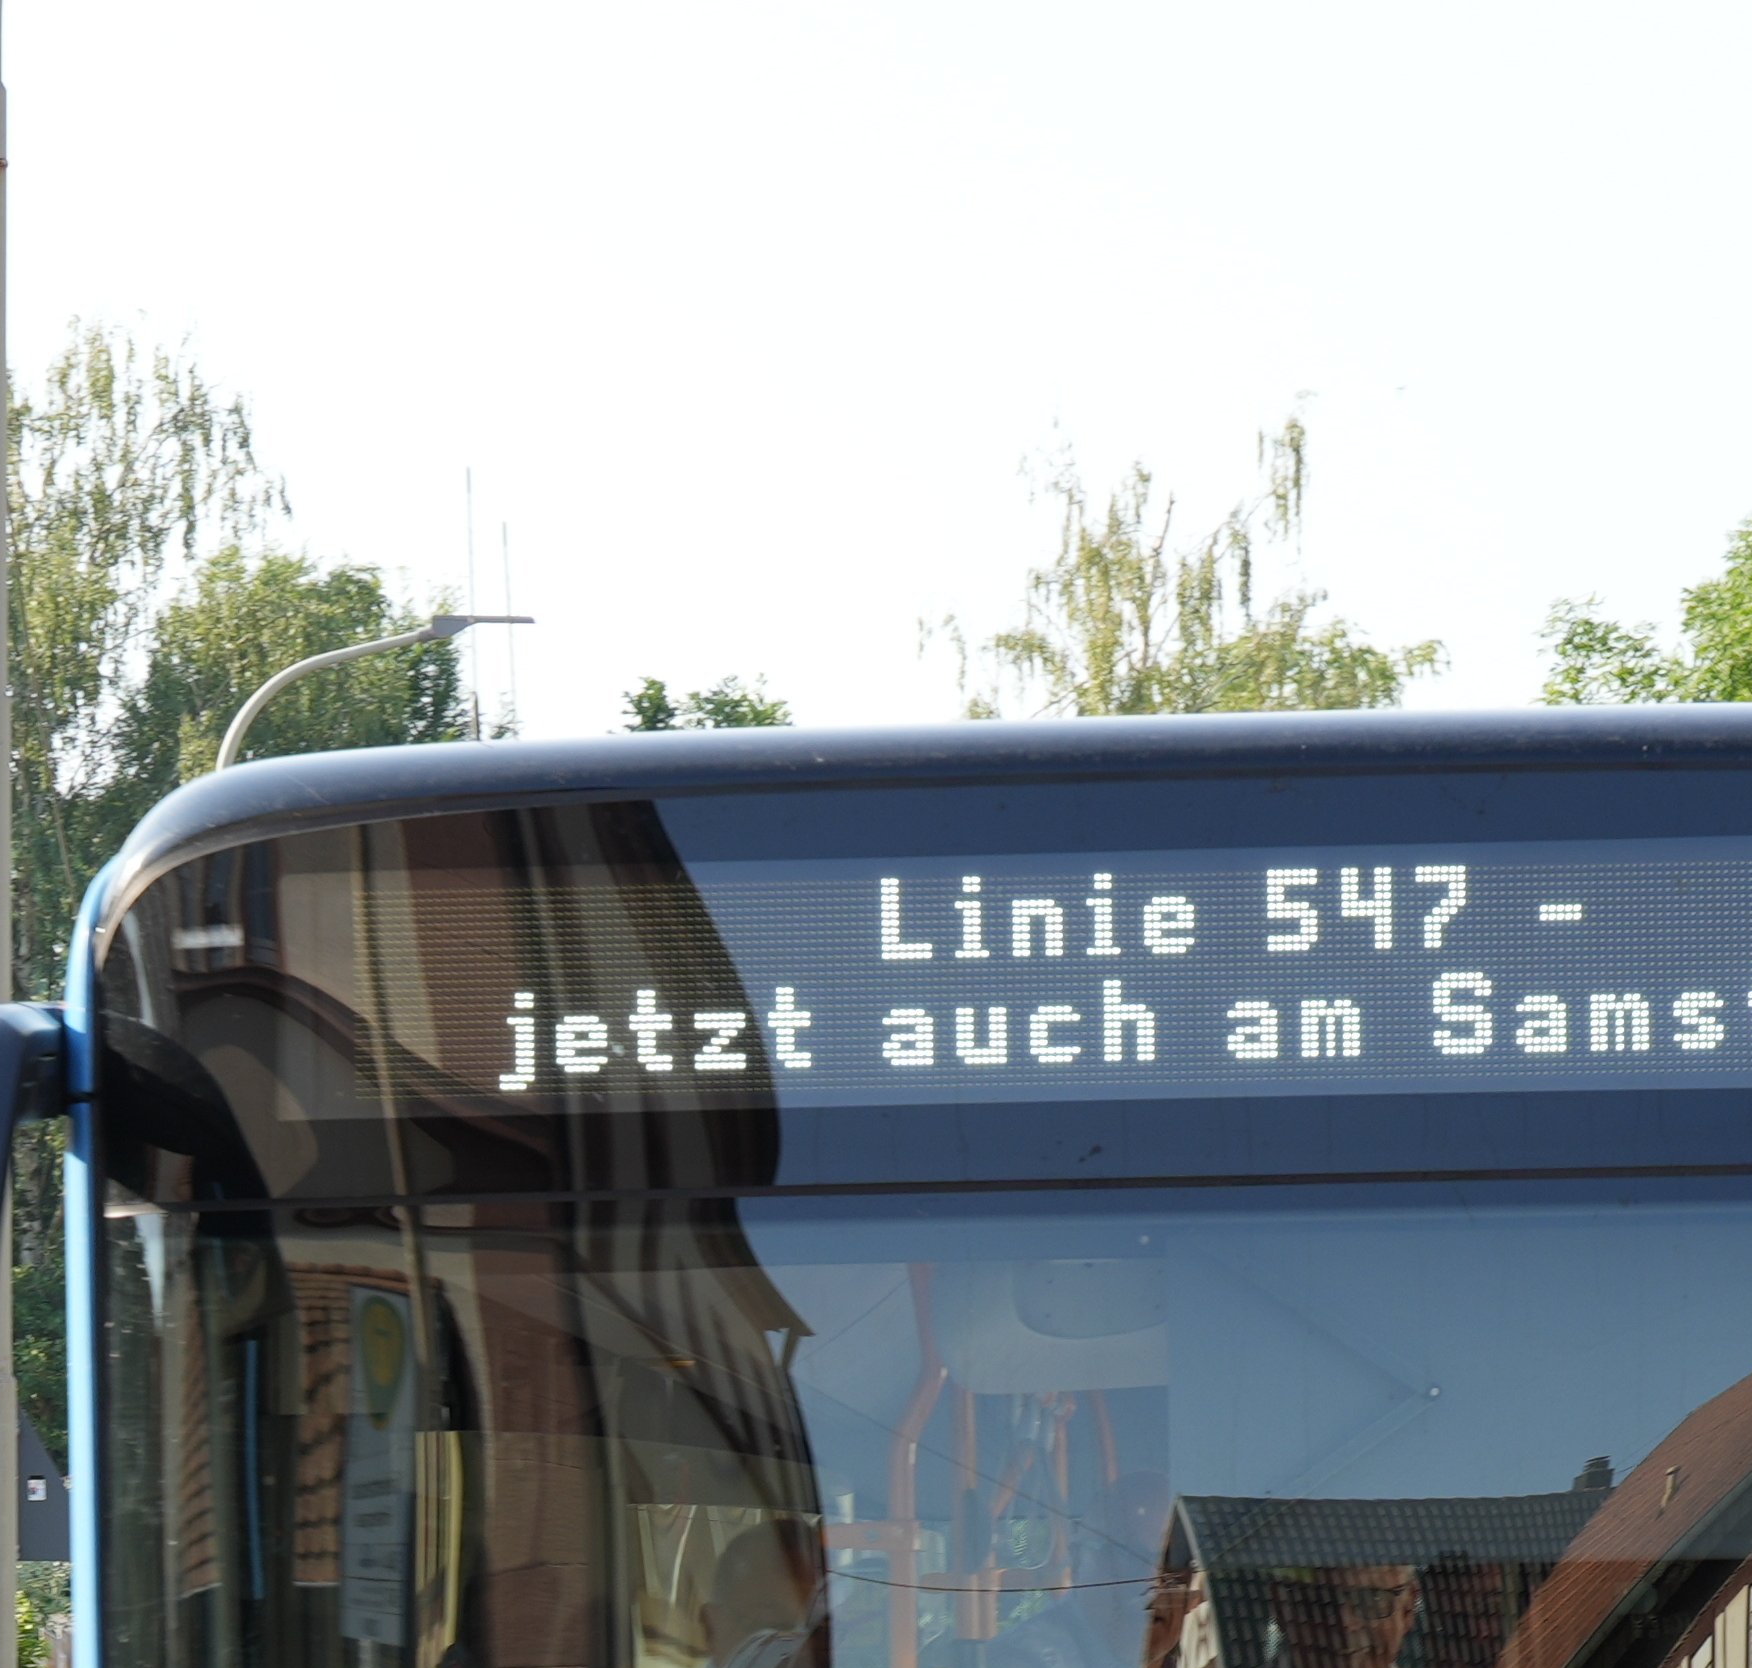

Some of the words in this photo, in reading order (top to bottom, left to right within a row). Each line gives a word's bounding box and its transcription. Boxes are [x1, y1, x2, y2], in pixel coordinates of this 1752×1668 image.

[880, 872, 1196, 959] Linie
[1265, 864, 1467, 952] 547
[498, 986, 813, 1091] jetzt
[881, 978, 1156, 1067] auch
[1226, 999, 1362, 1060] am
